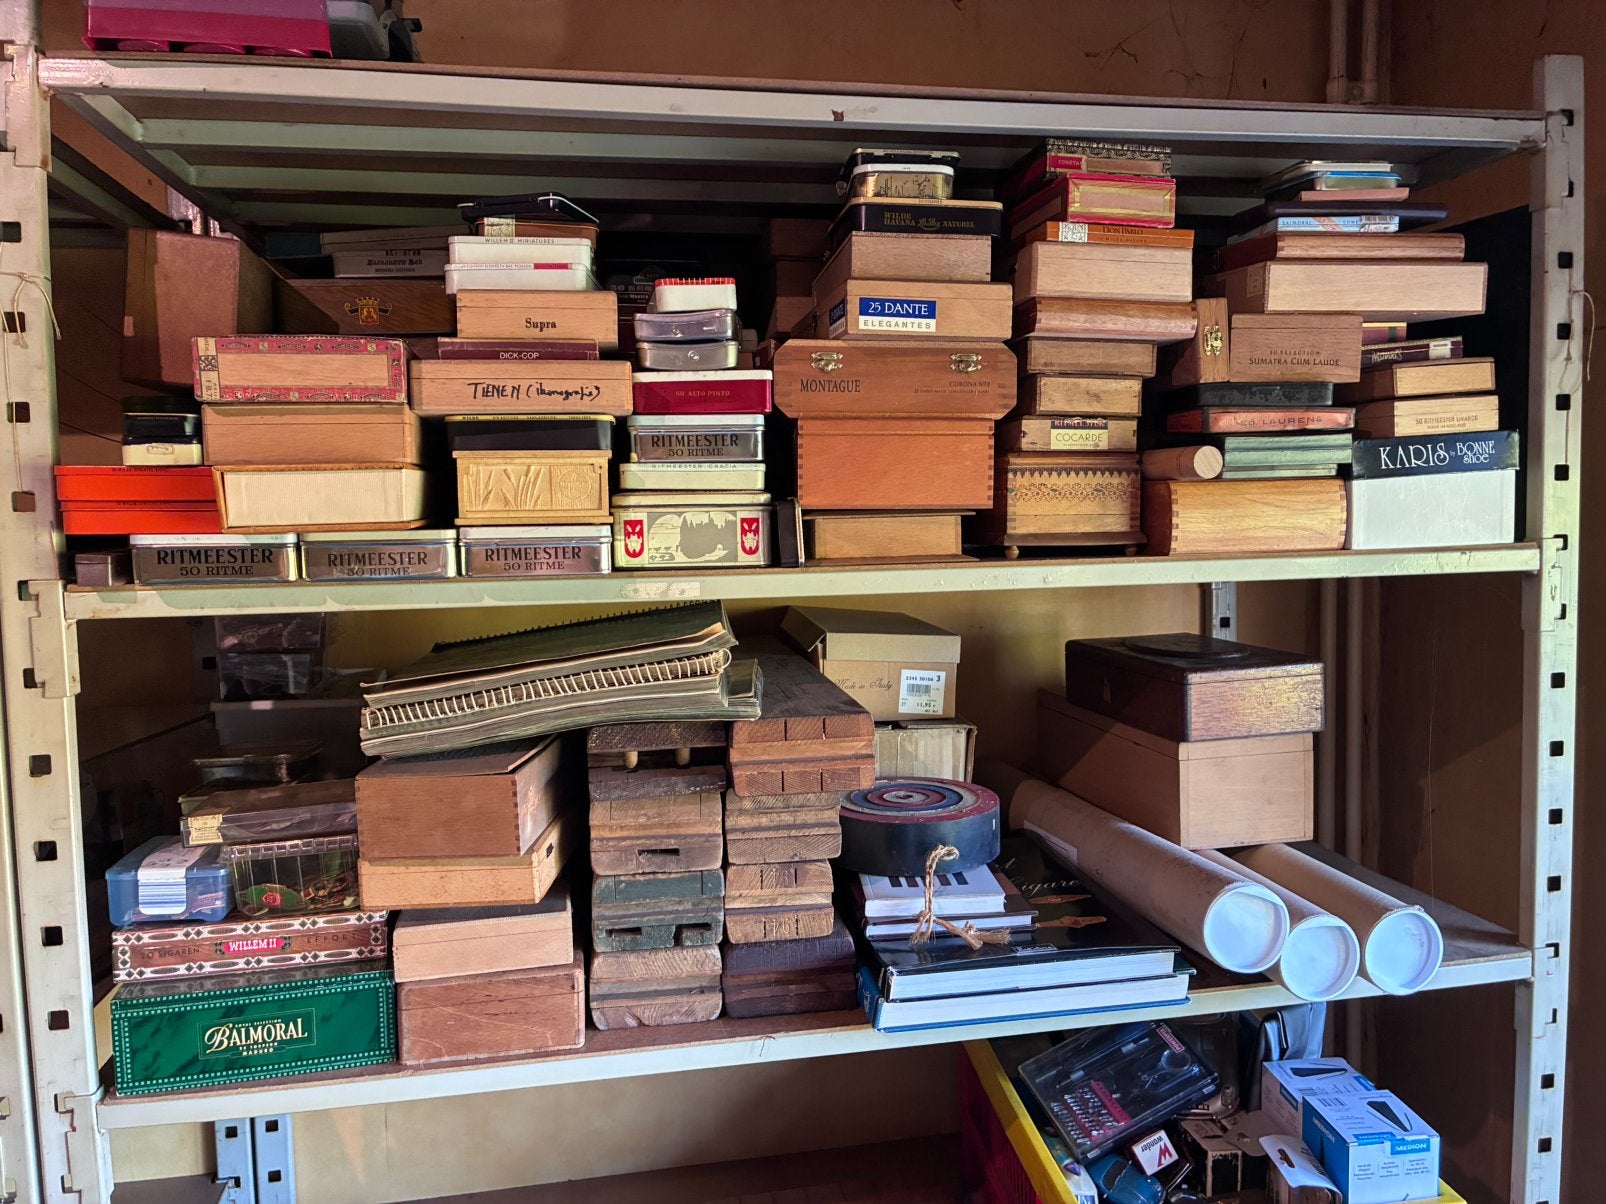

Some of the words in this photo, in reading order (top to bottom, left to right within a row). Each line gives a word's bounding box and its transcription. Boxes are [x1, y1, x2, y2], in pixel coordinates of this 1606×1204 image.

[868, 302, 881, 313] 25
[884, 302, 928, 315] DANTE
[525, 318, 557, 332] Supra
[864, 320, 931, 329] ELEGANTES
[1313, 358, 1340, 366] LAUDE
[800, 379, 861, 393] MONTAGUE
[651, 434, 739, 448] RITMEESTER
[1056, 433, 1104, 442] COCARDE
[668, 449, 684, 457] 50
[688, 448, 724, 457] RITME
[1379, 443, 1449, 469] KARIS
[1456, 440, 1495, 456] BONNE
[1463, 452, 1489, 464] shoe
[157, 549, 273, 565] RITMEESTER
[328, 552, 428, 567] RITMEESTER
[485, 546, 582, 562] RITMEESTER
[180, 566, 200, 576] 50
[206, 566, 254, 576] RITME
[369, 567, 410, 576] RITME
[503, 562, 521, 571] 50
[525, 561, 565, 571] RITME
[158, 947, 200, 959] SIGAREN
[229, 940, 268, 951] WILLEM
[269, 938, 277, 949] II
[307, 934, 358, 944] EFFORT
[204, 1018, 308, 1054] BALMORAL
[1141, 1136, 1164, 1152] wonder
[1395, 1142, 1427, 1151] MEDION
